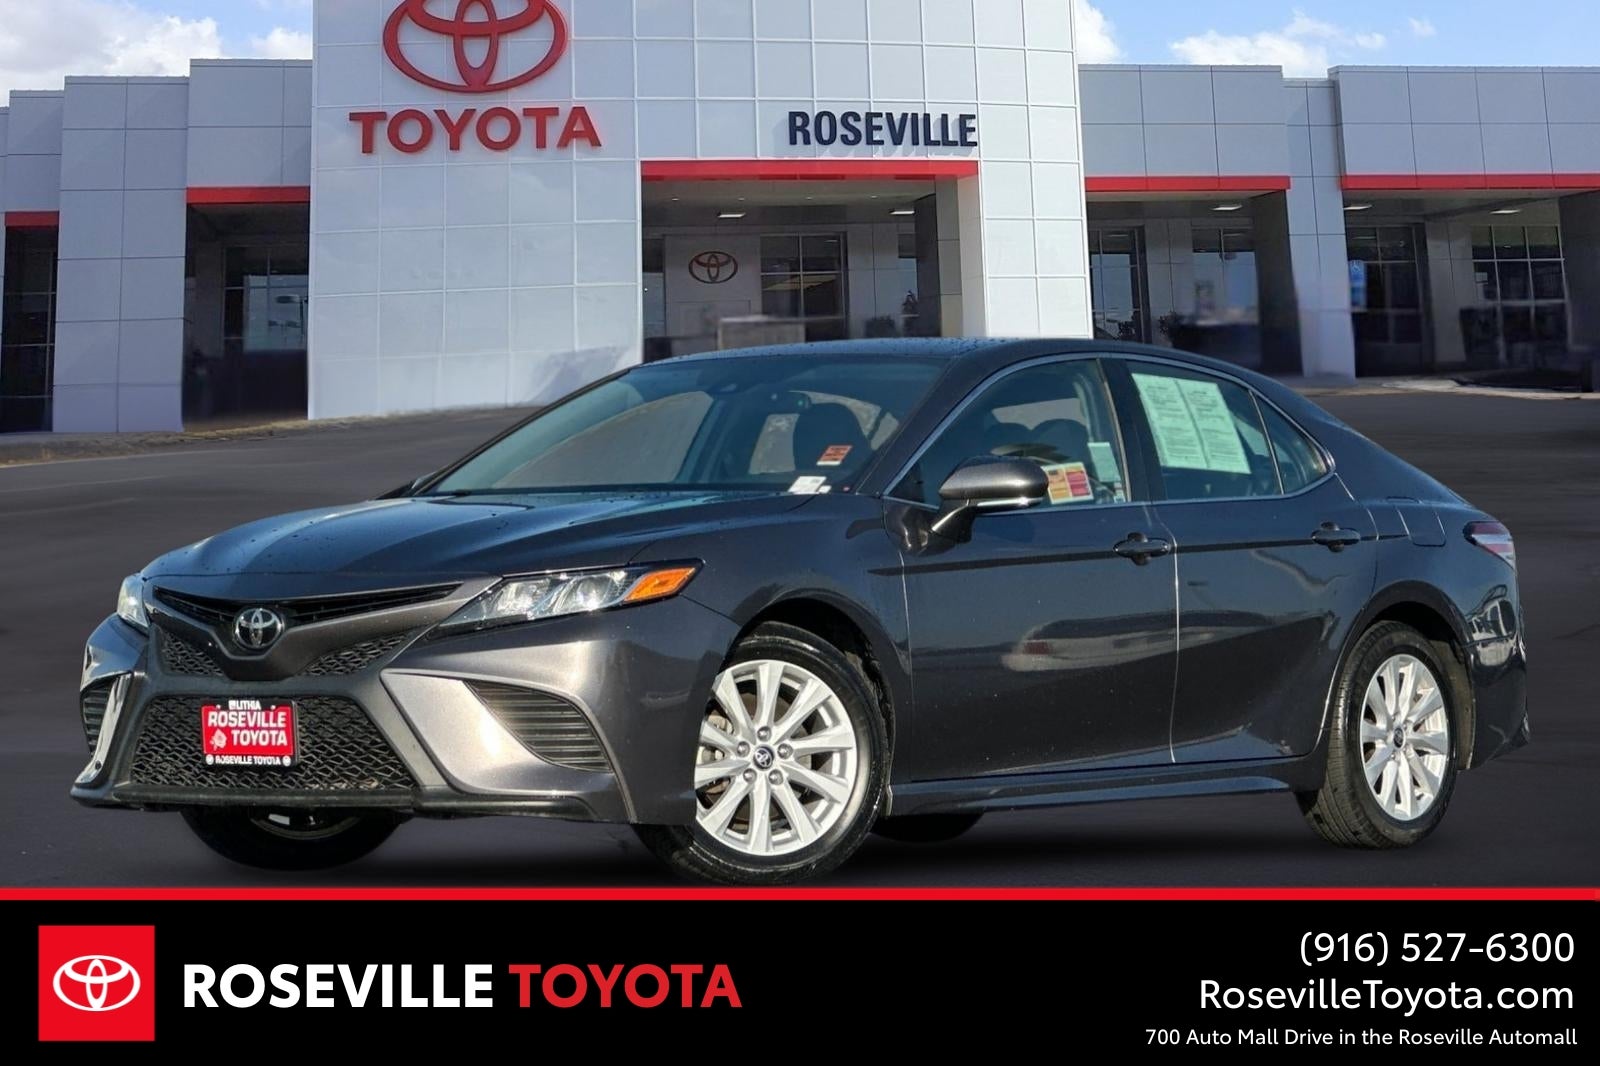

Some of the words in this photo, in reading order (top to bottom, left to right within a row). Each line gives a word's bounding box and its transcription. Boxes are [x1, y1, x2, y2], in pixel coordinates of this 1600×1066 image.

[349, 106, 602, 153] TOYOTA
[788, 110, 978, 147] ROSEVILLE
[236, 700, 261, 710] LITHIA
[208, 711, 286, 727] ROSEVILLE
[231, 729, 288, 746] TOYOTA
[215, 755, 252, 765] ROSEVILLE
[253, 756, 281, 766] TOYOTA
